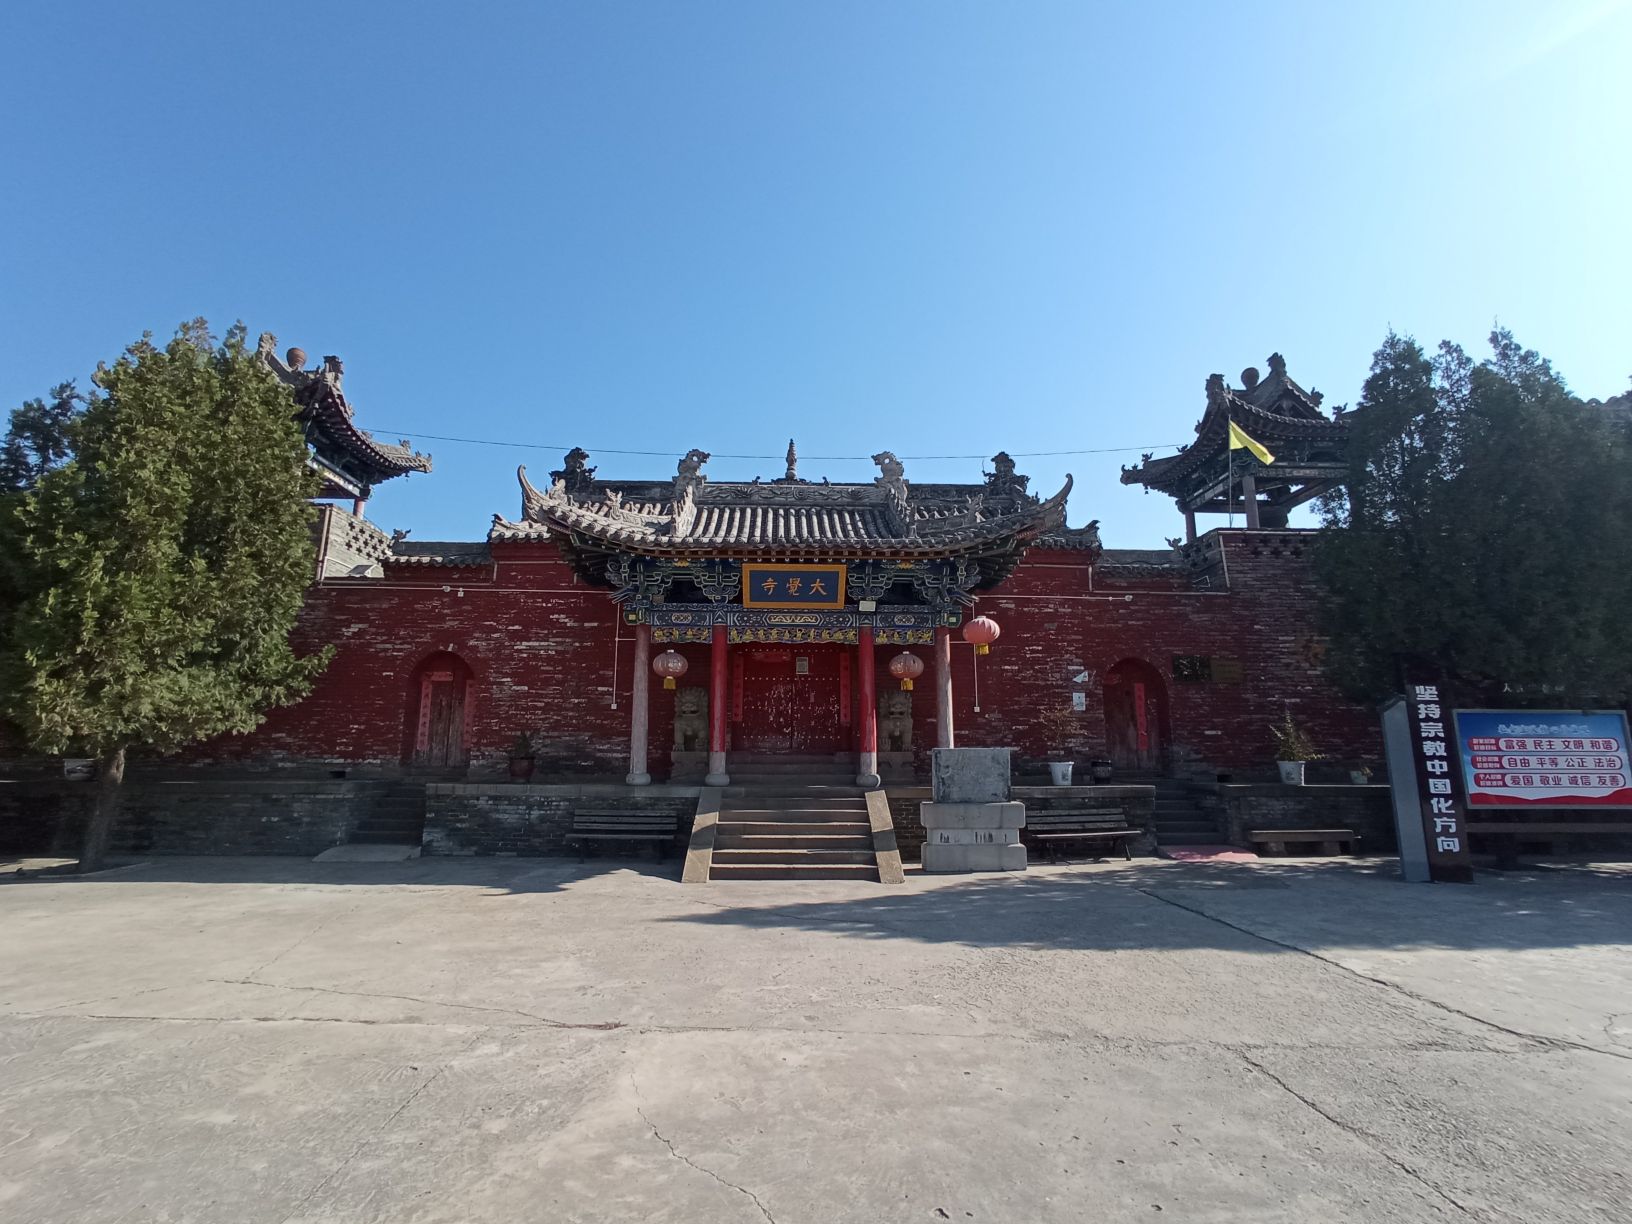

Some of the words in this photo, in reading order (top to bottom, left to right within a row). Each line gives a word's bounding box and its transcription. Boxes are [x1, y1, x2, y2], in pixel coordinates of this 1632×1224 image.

[1504, 740, 1528, 750] 富强
[1533, 740, 1556, 750] 民主
[1561, 740, 1584, 750] 文明
[1590, 740, 1613, 750] 和谐
[1508, 758, 1530, 768] 自由
[1536, 758, 1559, 768] 平等
[1565, 758, 1588, 768] 公正
[1594, 758, 1616, 768] 法治
[1415, 685, 1460, 853] 坚持宗教中国化方向
[1510, 775, 1533, 786] 爱国
[1539, 775, 1562, 786] 敬业
[1568, 775, 1591, 786] 诚信
[1597, 775, 1620, 786] 友善
